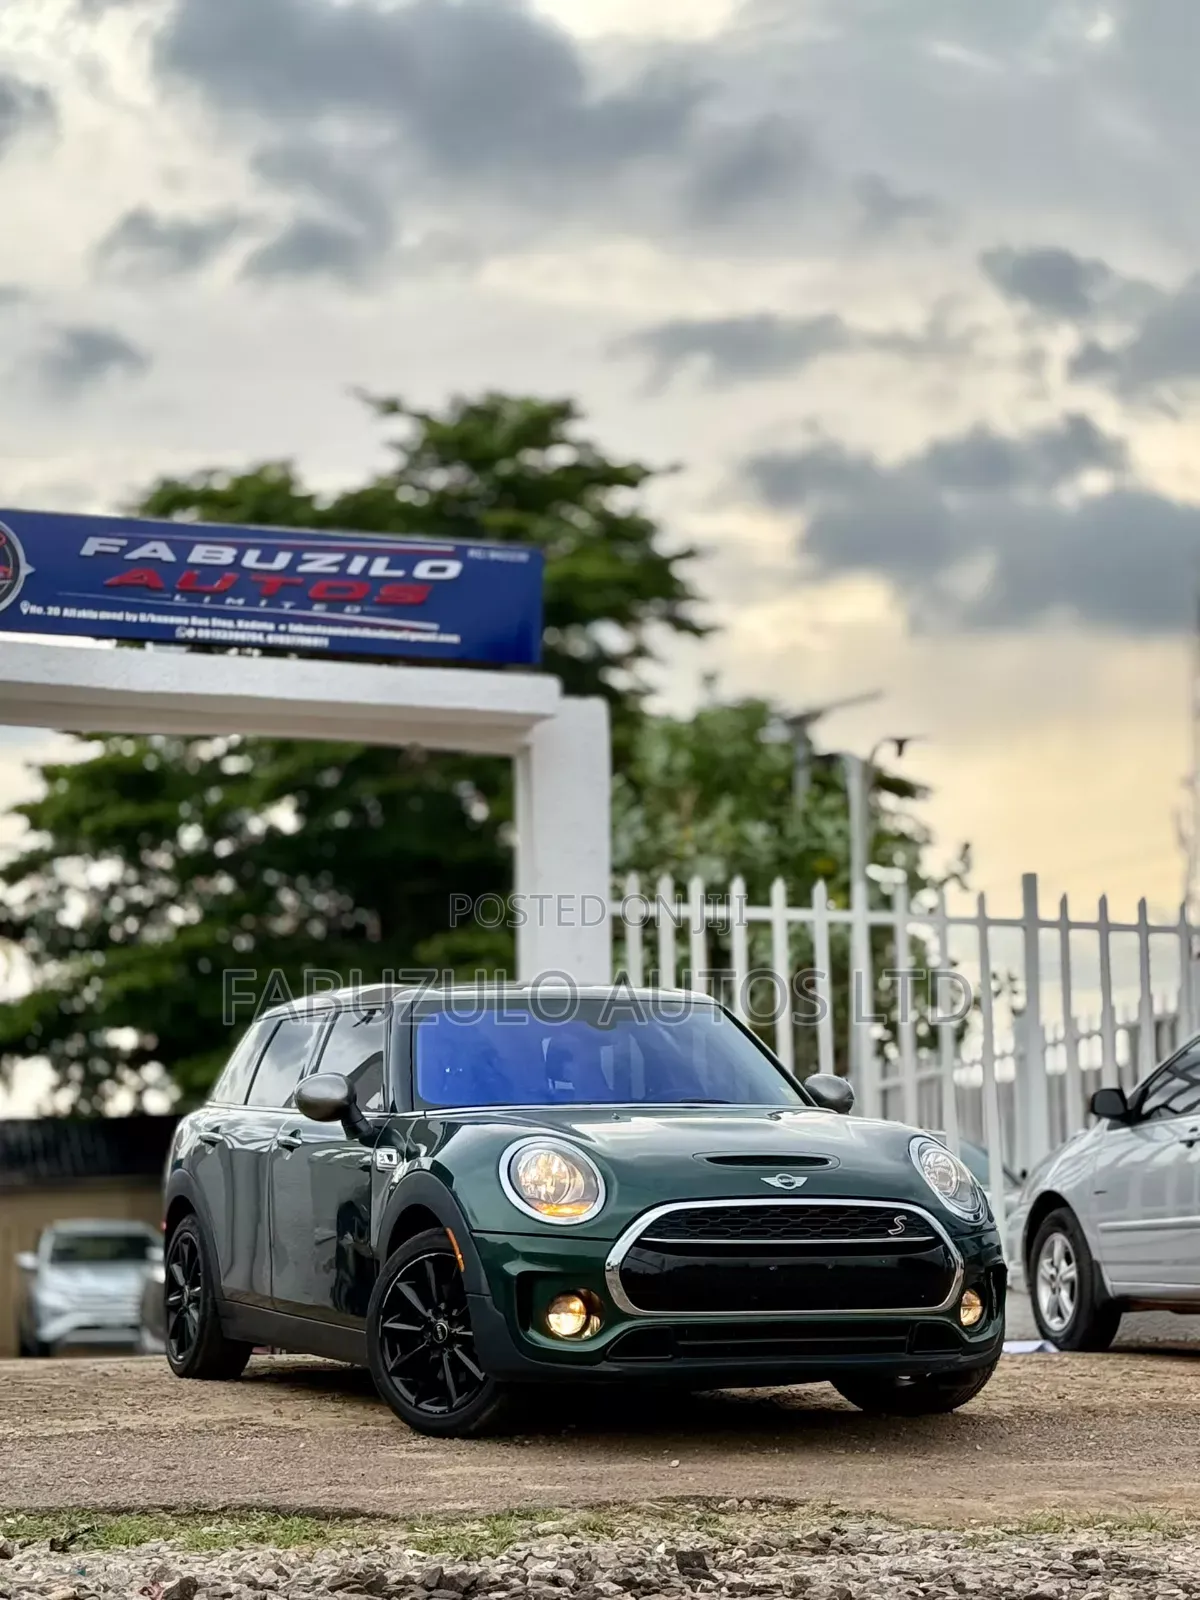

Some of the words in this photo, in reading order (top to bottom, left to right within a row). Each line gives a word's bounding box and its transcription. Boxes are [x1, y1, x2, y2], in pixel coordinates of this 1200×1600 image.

[79, 535, 463, 580] FABUZILO
[103, 567, 433, 606] AUTOS
[173, 594, 362, 613] LIMITED
